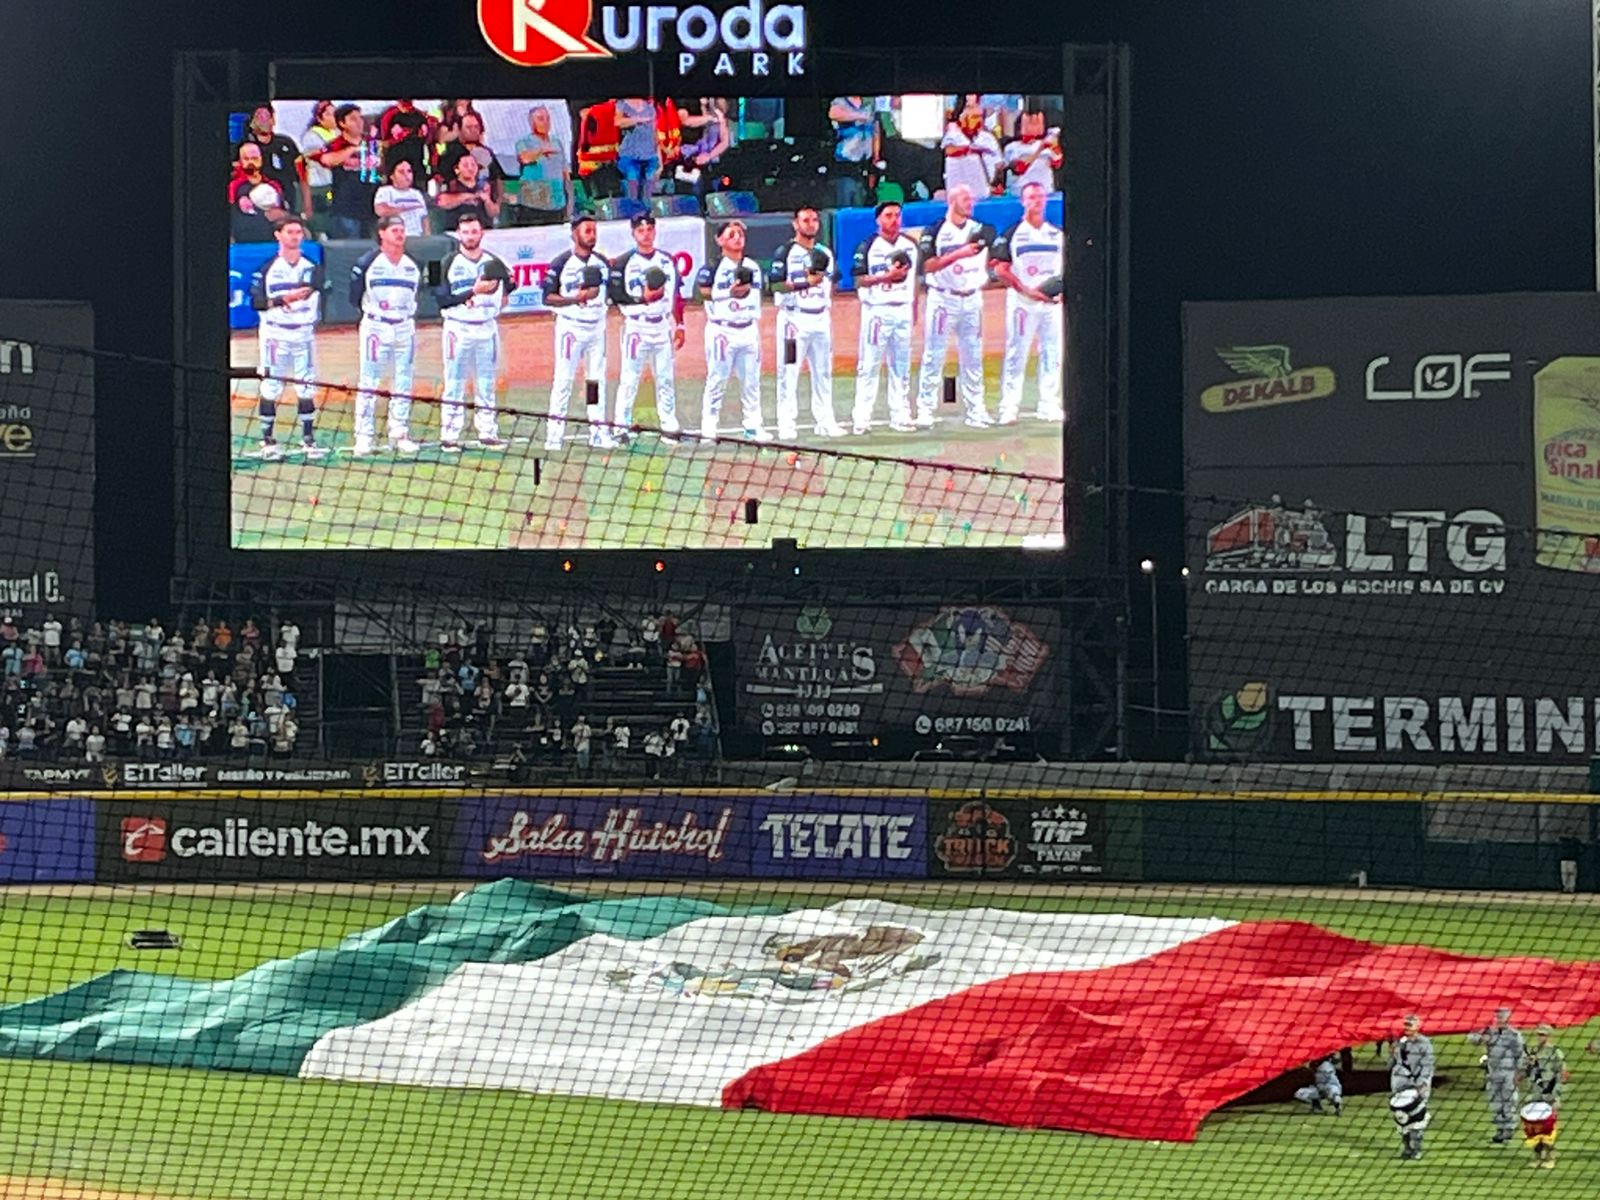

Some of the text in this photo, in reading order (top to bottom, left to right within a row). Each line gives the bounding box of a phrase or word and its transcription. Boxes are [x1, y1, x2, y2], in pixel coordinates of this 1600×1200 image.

[679, 53, 805, 76] PARK
[1223, 375, 1316, 407] DEKALB
[1346, 509, 1506, 573] LTG
[1205, 579, 1268, 594] CARGA
[1272, 579, 1298, 594] DE
[1301, 579, 1338, 594] LOS
[1419, 579, 1446, 594] SA
[1449, 579, 1475, 594] DE
[1479, 579, 1506, 594] CV
[1277, 696, 1600, 754] TERMIN
[170, 818, 431, 858] caliente.mx
[484, 807, 733, 862] Salsa Huichol
[759, 813, 915, 858] TECATE
[943, 838, 1010, 856] TRUCK
